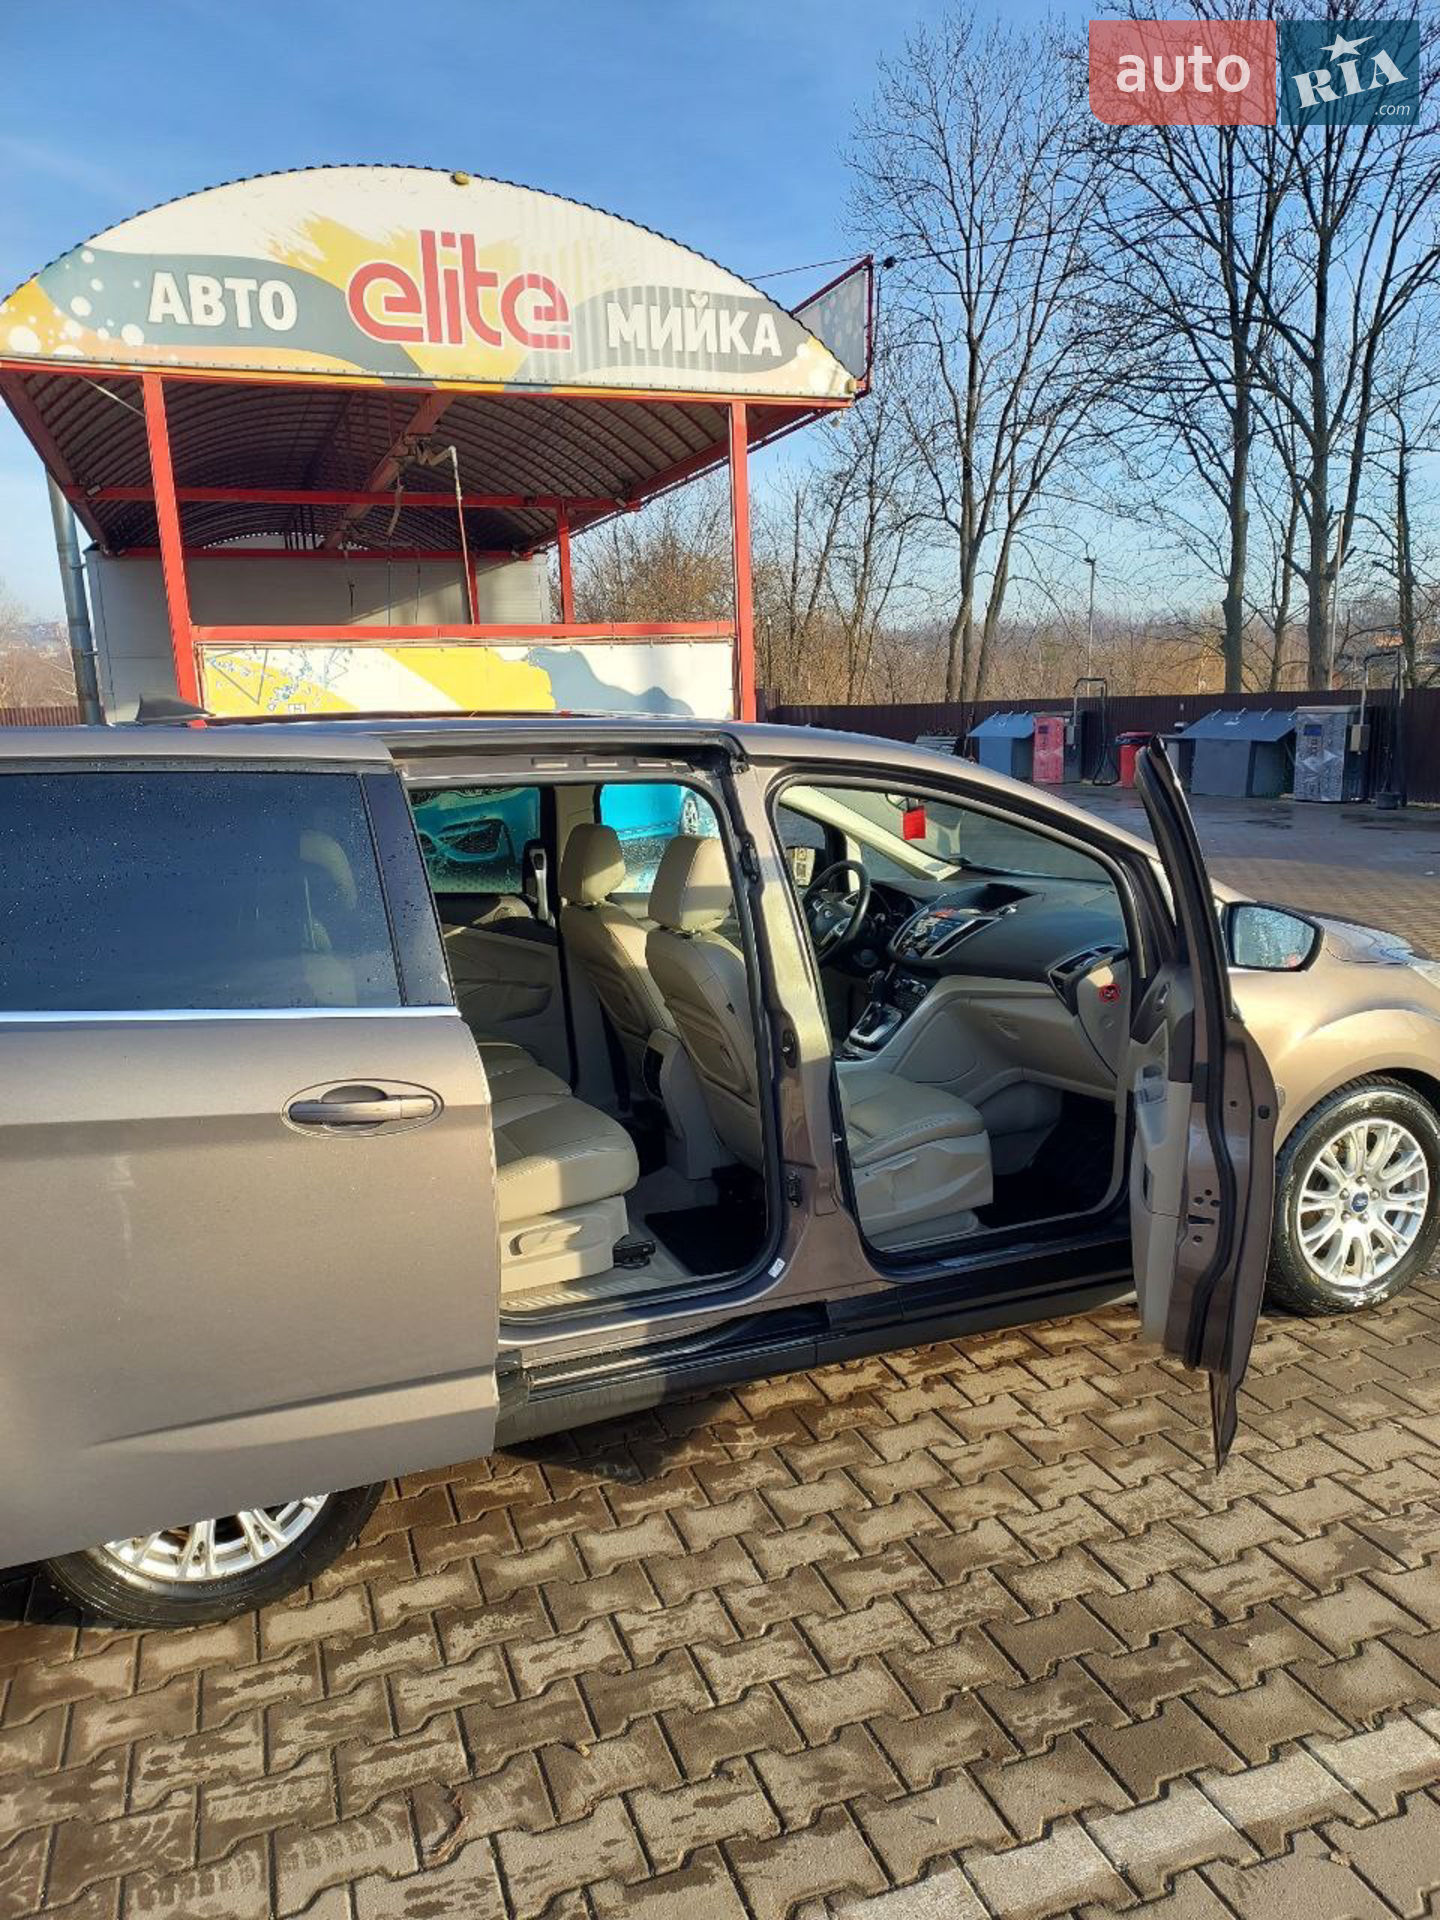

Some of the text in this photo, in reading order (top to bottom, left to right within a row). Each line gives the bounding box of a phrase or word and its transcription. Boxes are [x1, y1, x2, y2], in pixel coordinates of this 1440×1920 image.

[148, 271, 298, 331] АВТО
[348, 229, 571, 350] elite
[607, 293, 782, 357] МИЙКА
